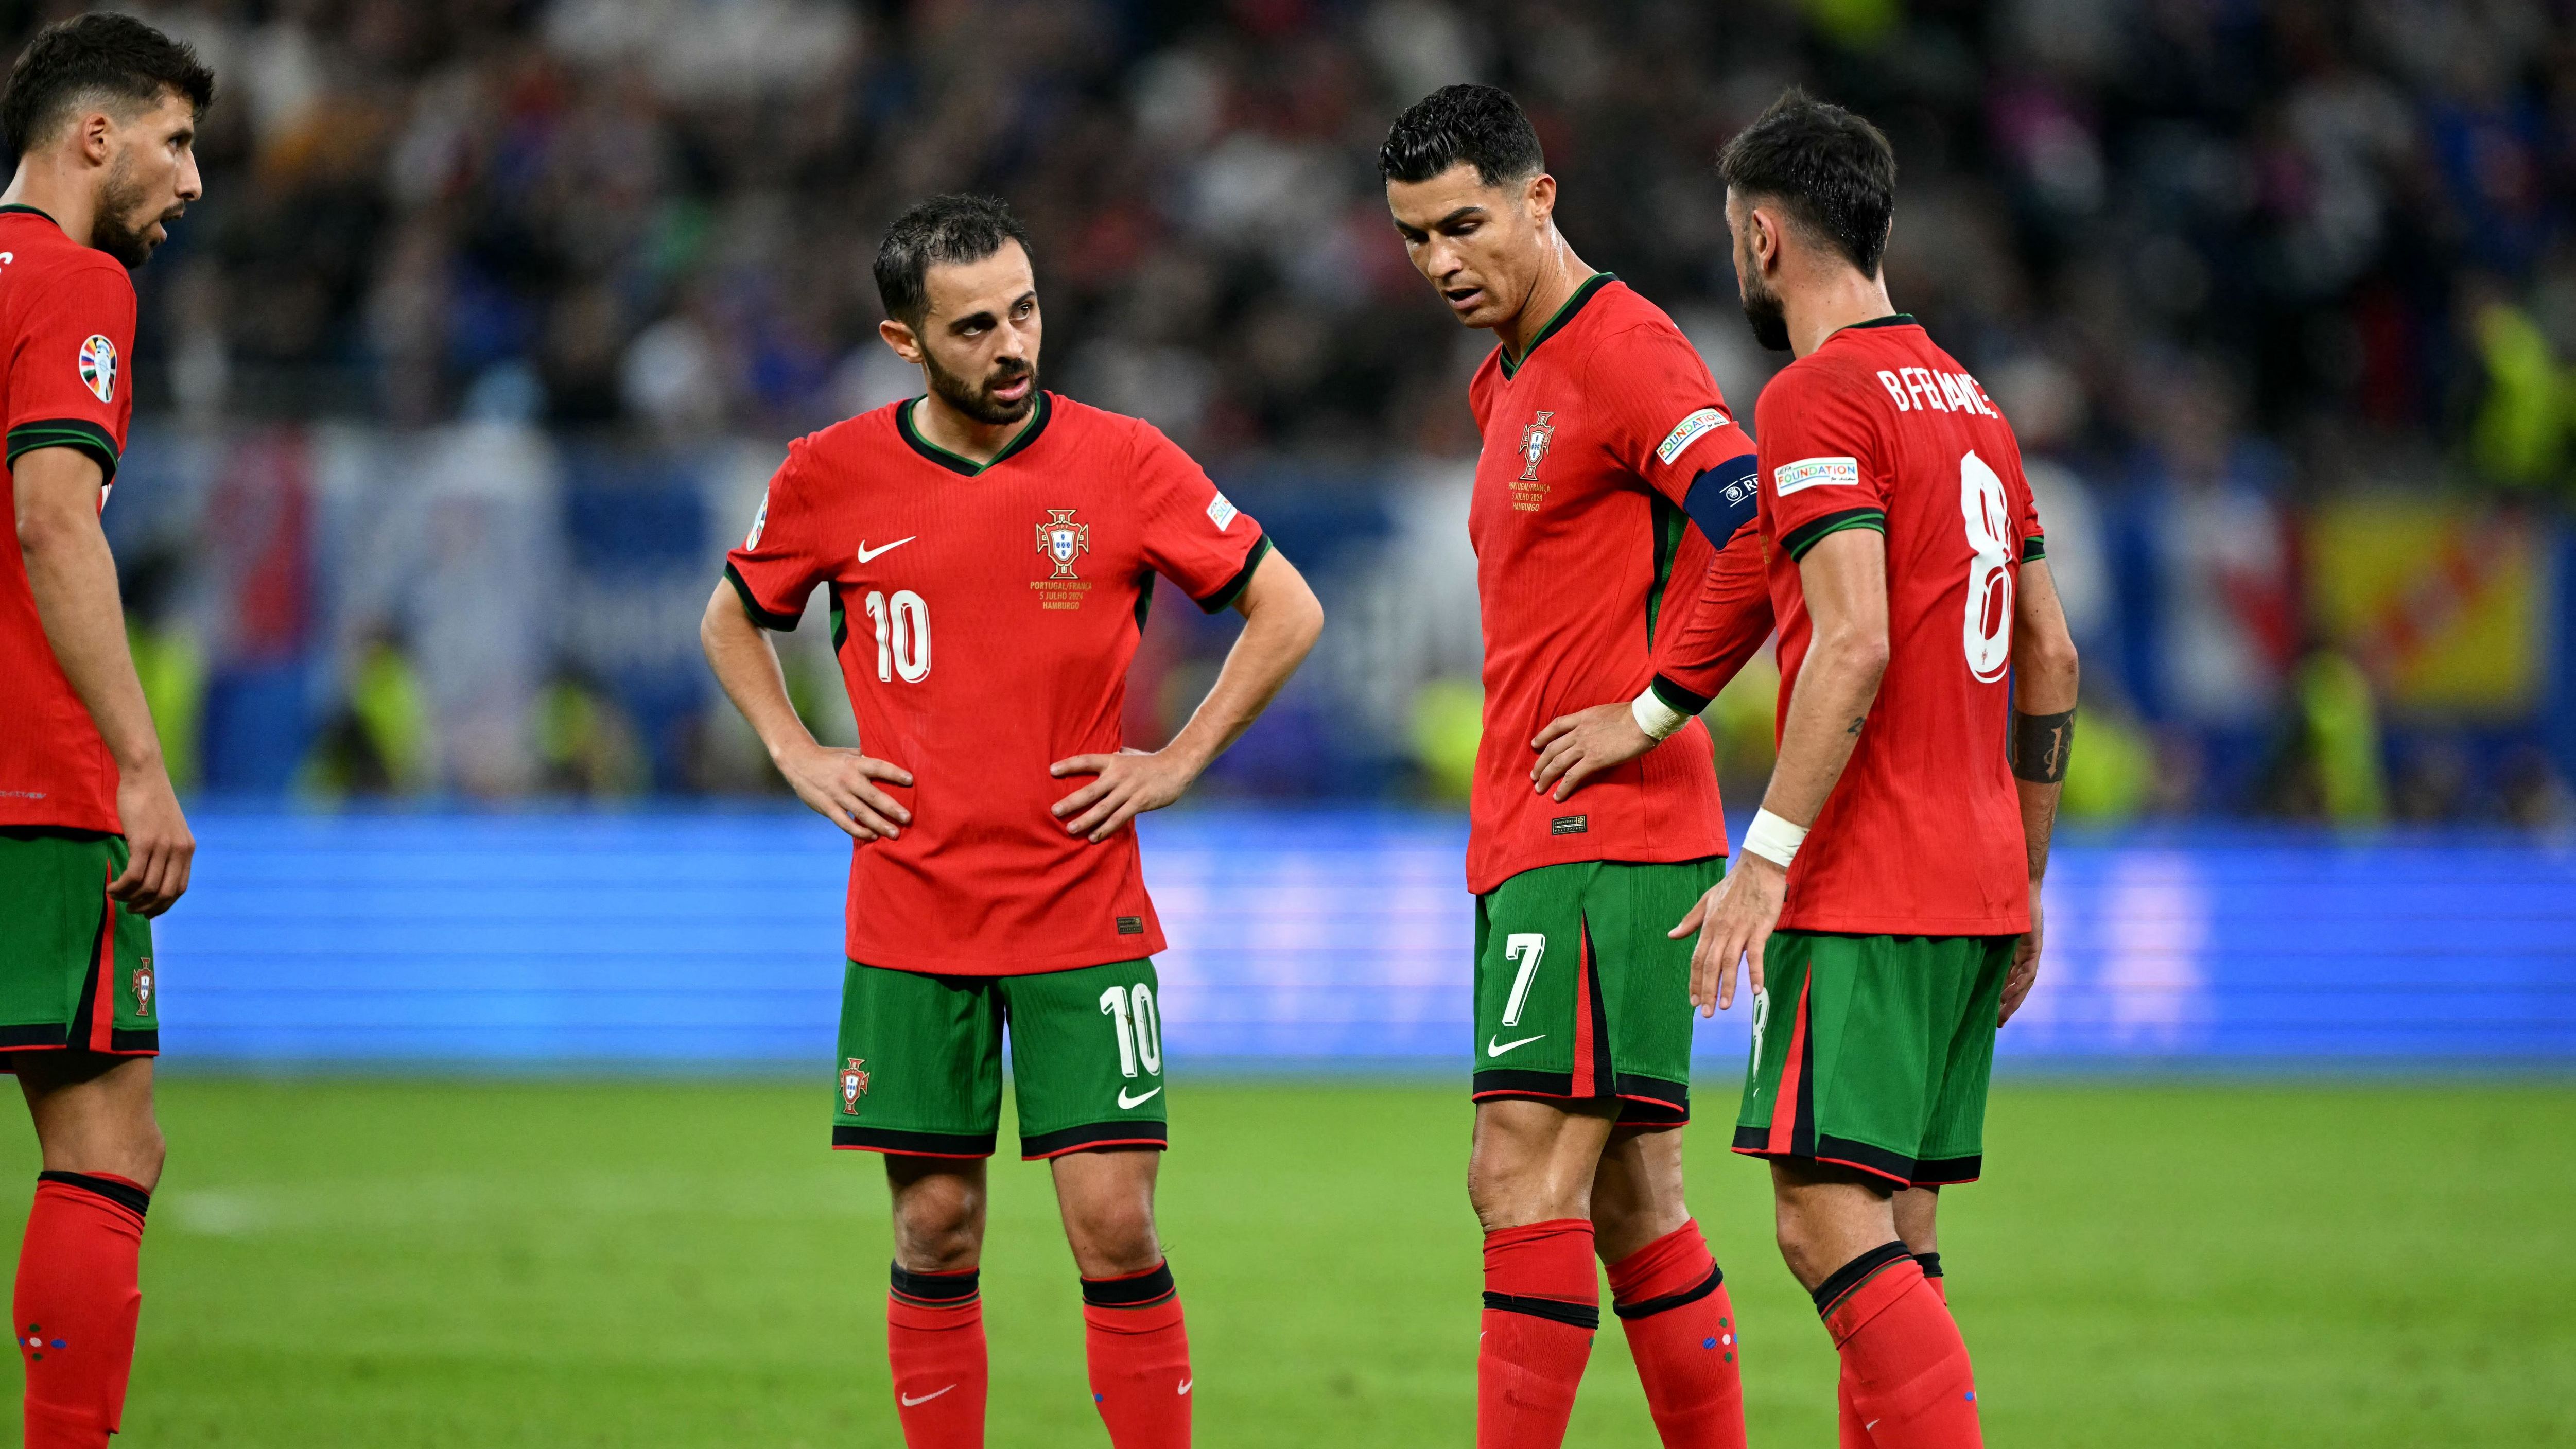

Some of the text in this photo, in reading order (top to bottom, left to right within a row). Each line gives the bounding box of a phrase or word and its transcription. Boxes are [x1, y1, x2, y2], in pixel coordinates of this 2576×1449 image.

[1777, 466, 1792, 475] UEFA
[1778, 466, 1855, 485] FOUNDATION
[1508, 482, 1551, 494] PORTUGAL/FRANÇA
[1515, 493, 1529, 501] JULHO
[1530, 494, 1543, 502] 2024
[1513, 502, 1539, 511] HAMBURGO
[1960, 449, 2012, 683] 8
[1030, 581, 1092, 592] PORTUGAL/FRANÇA
[1039, 591, 1083, 600] 5 JULHO 2024
[1042, 601, 1080, 610] HAMBURGO
[866, 590, 931, 684] 10
[1502, 933, 1546, 1026] 7
[1100, 983, 1161, 1077] 10
